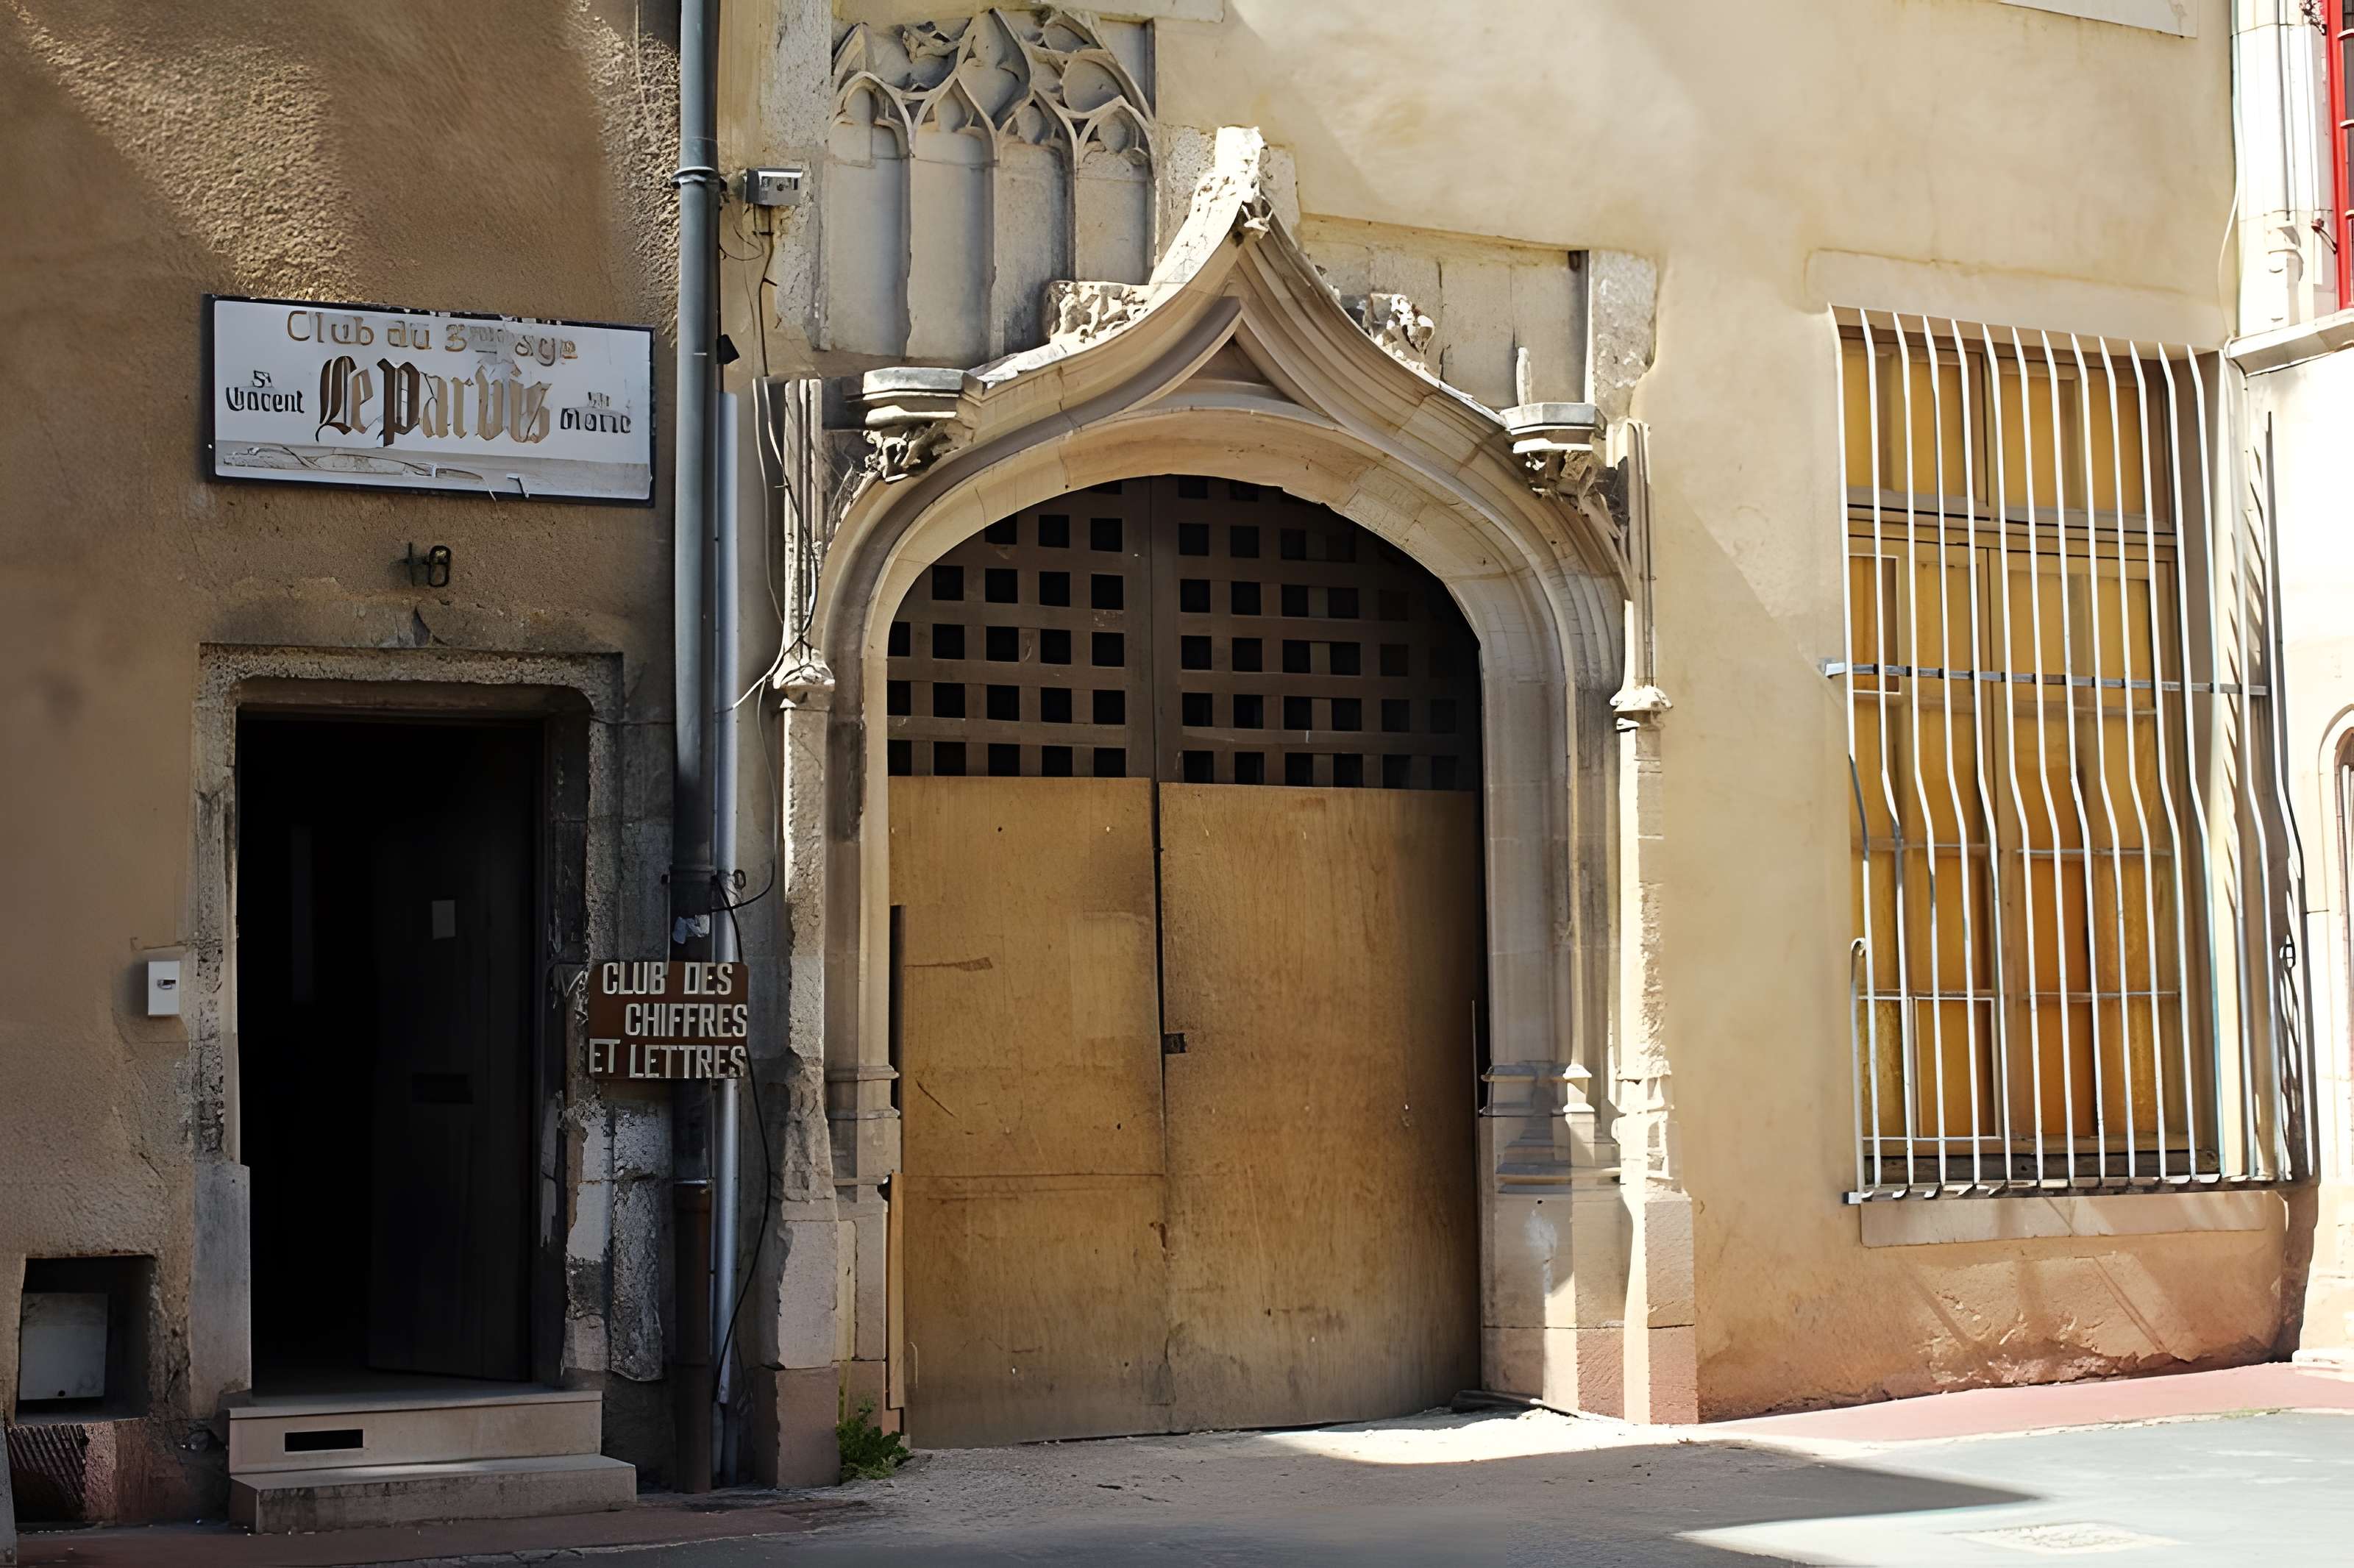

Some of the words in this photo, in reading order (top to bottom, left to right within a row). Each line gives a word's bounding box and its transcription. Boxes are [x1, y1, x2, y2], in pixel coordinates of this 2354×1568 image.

[287, 310, 374, 346] Club
[387, 319, 433, 350] du
[316, 355, 374, 443] Le
[602, 961, 666, 995] CLUB
[683, 961, 733, 996] DES
[625, 1002, 748, 1038] CHIFFRES
[589, 1038, 622, 1075] ET
[629, 1044, 747, 1079] LETTRES
